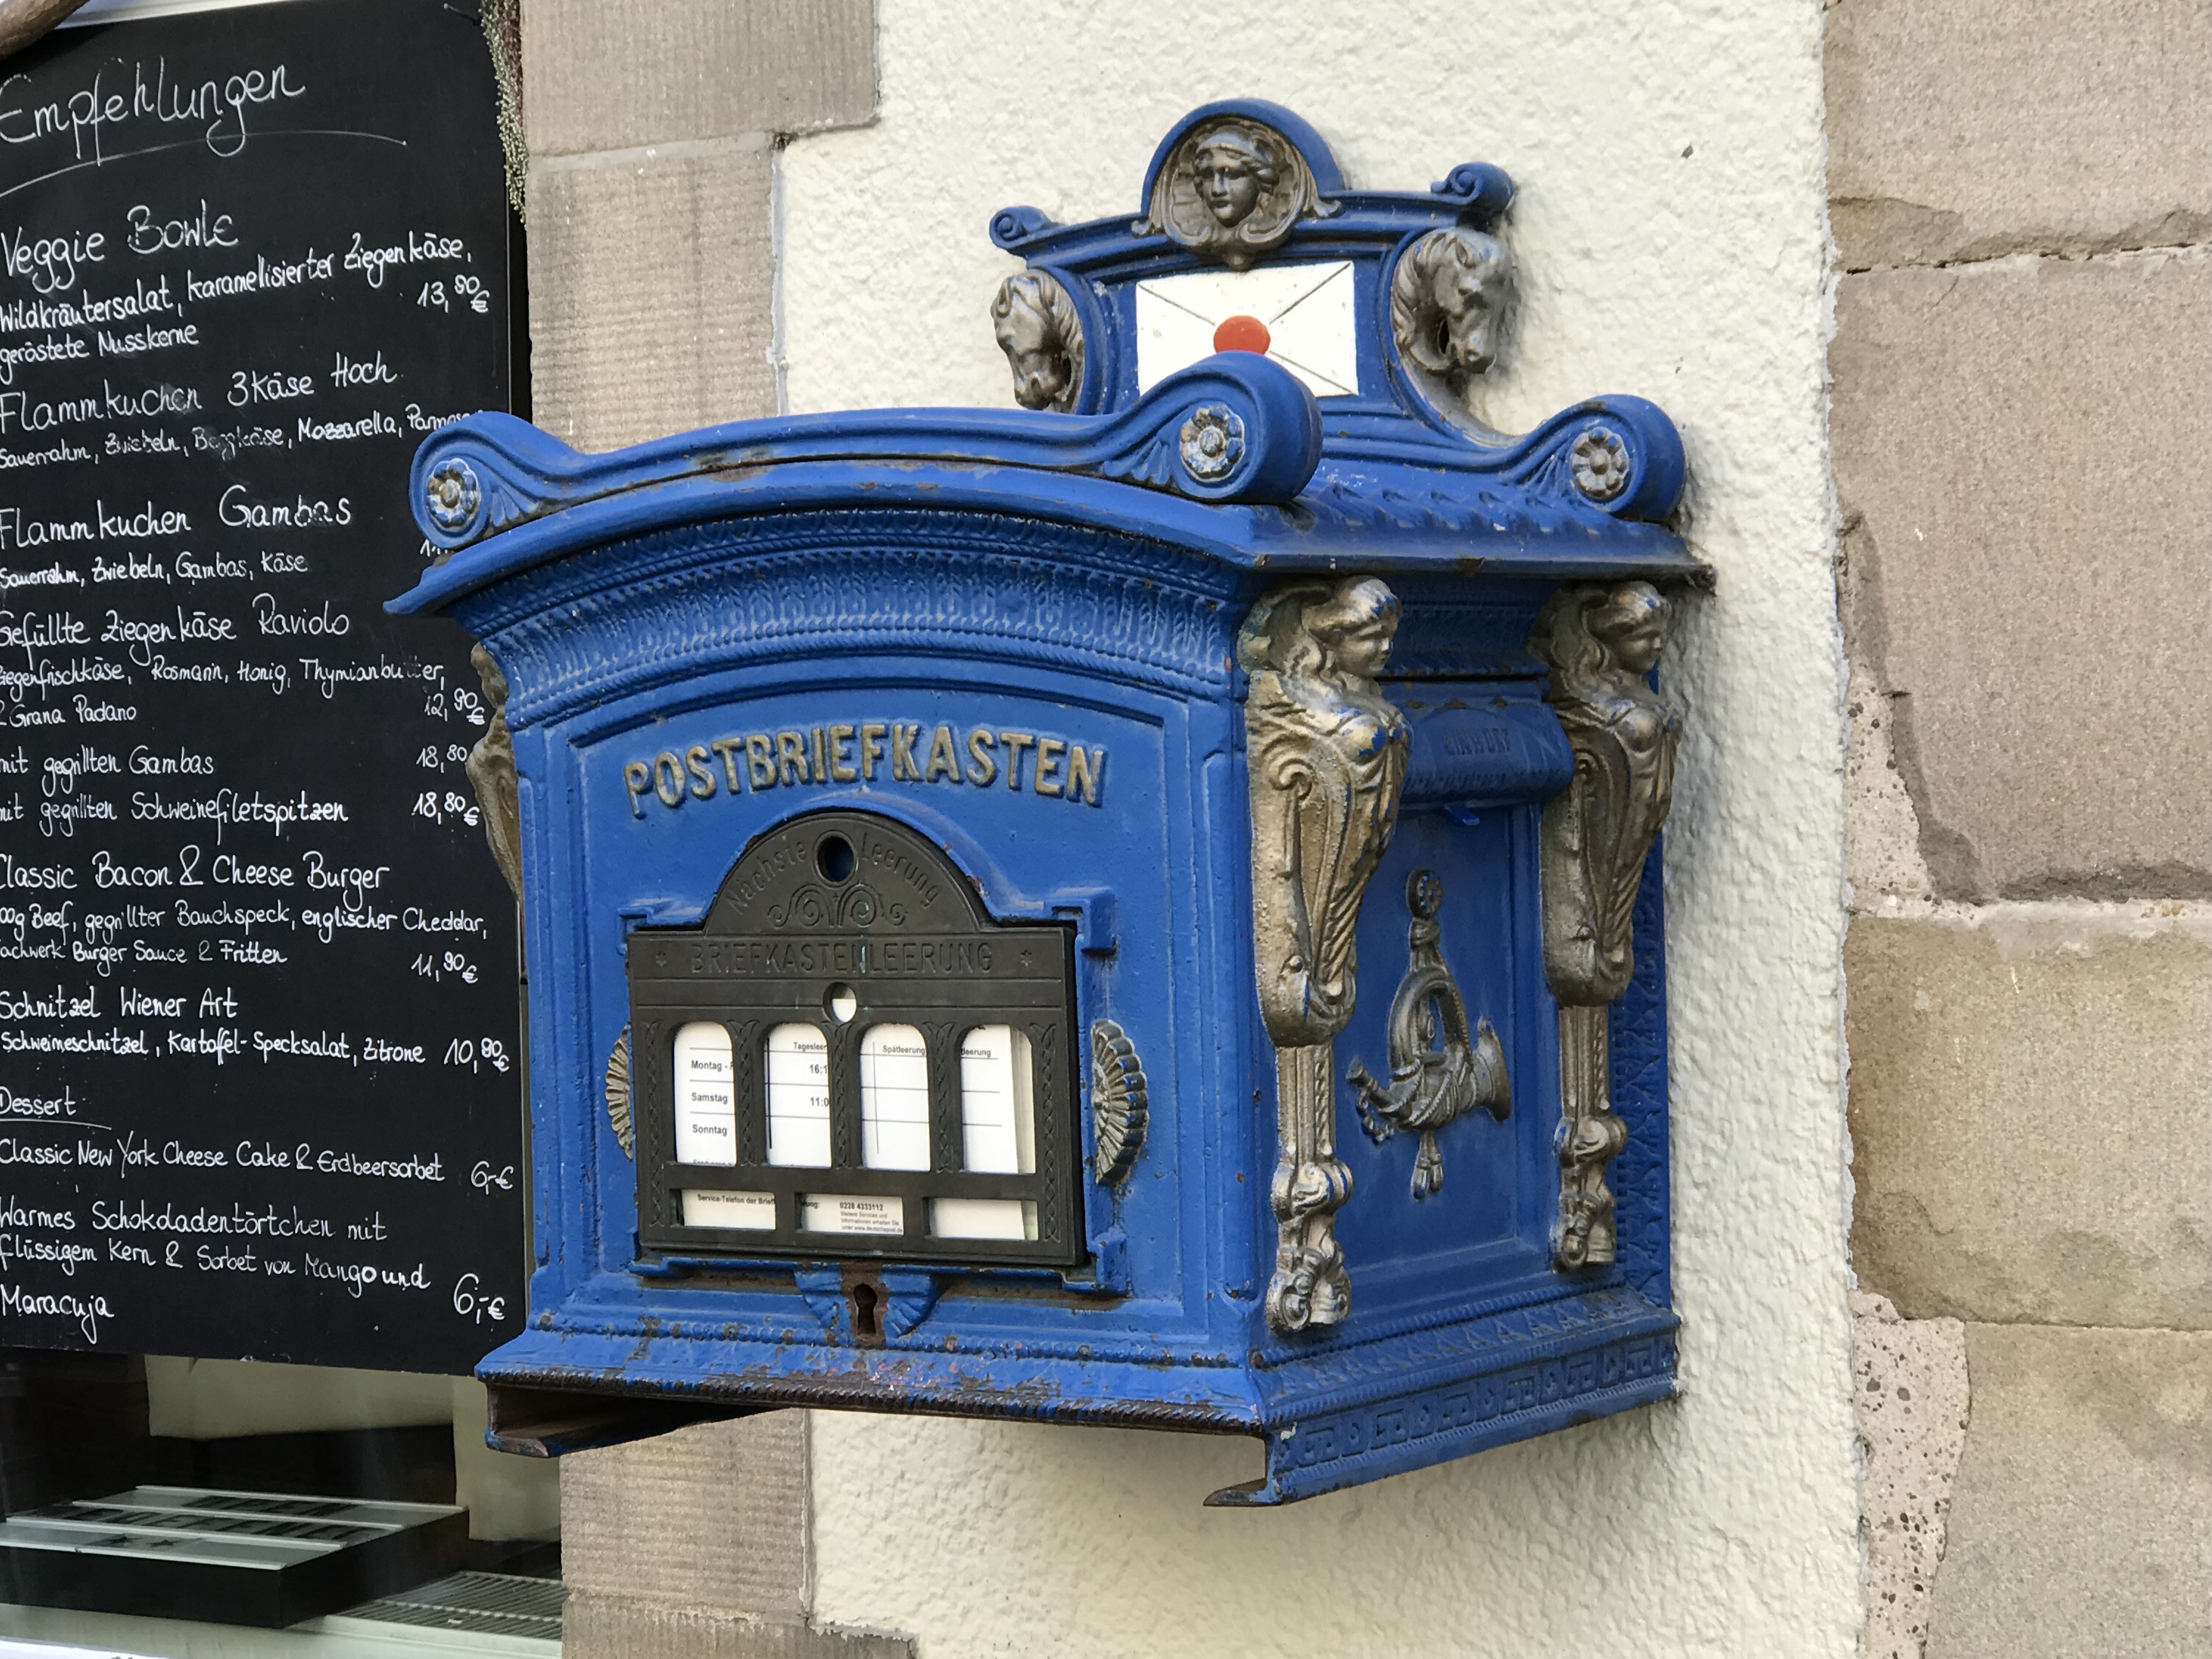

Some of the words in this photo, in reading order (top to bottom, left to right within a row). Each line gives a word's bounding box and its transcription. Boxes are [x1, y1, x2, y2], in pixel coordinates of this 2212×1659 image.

[0, 55, 306, 166] Empfehlungen
[1, 226, 105, 293] Veggie
[188, 247, 335, 302] karamellisierter
[344, 230, 471, 288] Ziegenkäse,
[0, 333, 89, 385] geröstete
[330, 351, 398, 387] Hoch
[0, 438, 99, 469] Sauerrahm,
[297, 410, 402, 442] Mozzarella,
[219, 484, 351, 528] Gambas
[0, 562, 86, 588] Sauerrahm,
[92, 551, 171, 584] Zwiebeln,
[176, 551, 253, 585] Gambas,
[261, 550, 308, 573] Käse
[0, 610, 91, 671] Gefüllte
[100, 605, 237, 667] Ziegenkäse
[252, 592, 349, 635] Raviolo
[237, 660, 291, 695] Honig,
[9, 703, 66, 727] Grana
[72, 693, 137, 724] Padano
[41, 744, 121, 798] gegrillten
[129, 744, 214, 775] Gambas
[623, 723, 1105, 817] POSTBRIEFKASTEN
[39, 793, 117, 837] gegrillten
[131, 788, 348, 845] Schweinefiletspitzen
[92, 850, 172, 889] Bacon
[179, 844, 204, 886] &
[213, 855, 295, 887] Cheese
[302, 850, 390, 912] Burger
[725, 838, 807, 916] Nächste
[860, 832, 940, 909] Leerung
[29, 900, 77, 946] Beef,
[85, 904, 166, 945] gegrillter
[175, 899, 295, 935] Bauchspeck,
[301, 905, 397, 943] englischer
[402, 907, 487, 940] Cheddar,
[72, 941, 127, 977] Burger
[133, 940, 188, 964] Sauce
[219, 940, 287, 964] Fritten
[0, 984, 101, 1020] Schnitzel
[120, 986, 187, 1017] Wiener
[199, 986, 238, 1018] Art
[363, 1037, 426, 1063] Zitrone
[691, 1060, 723, 1073] Montag
[883, 1045, 926, 1056] Spätleerung
[0, 1085, 76, 1116] Dessert
[691, 1092, 729, 1104] Samstag
[692, 1124, 727, 1137] Sonntag
[0, 1138, 73, 1165] Classic
[78, 1140, 112, 1167] New
[117, 1131, 159, 1178] York
[163, 1141, 228, 1166] Cheese
[236, 1141, 291, 1167] Cake
[295, 1142, 313, 1170] &
[0, 1195, 76, 1230] Warmes
[347, 1211, 387, 1240] mit
[109, 1238, 156, 1266] Kern
[165, 1240, 183, 1268] &
[196, 1244, 257, 1272] Sorbet
[263, 1259, 296, 1277] von
[383, 1263, 431, 1290] und
[1, 1283, 115, 1344] Maracuja
